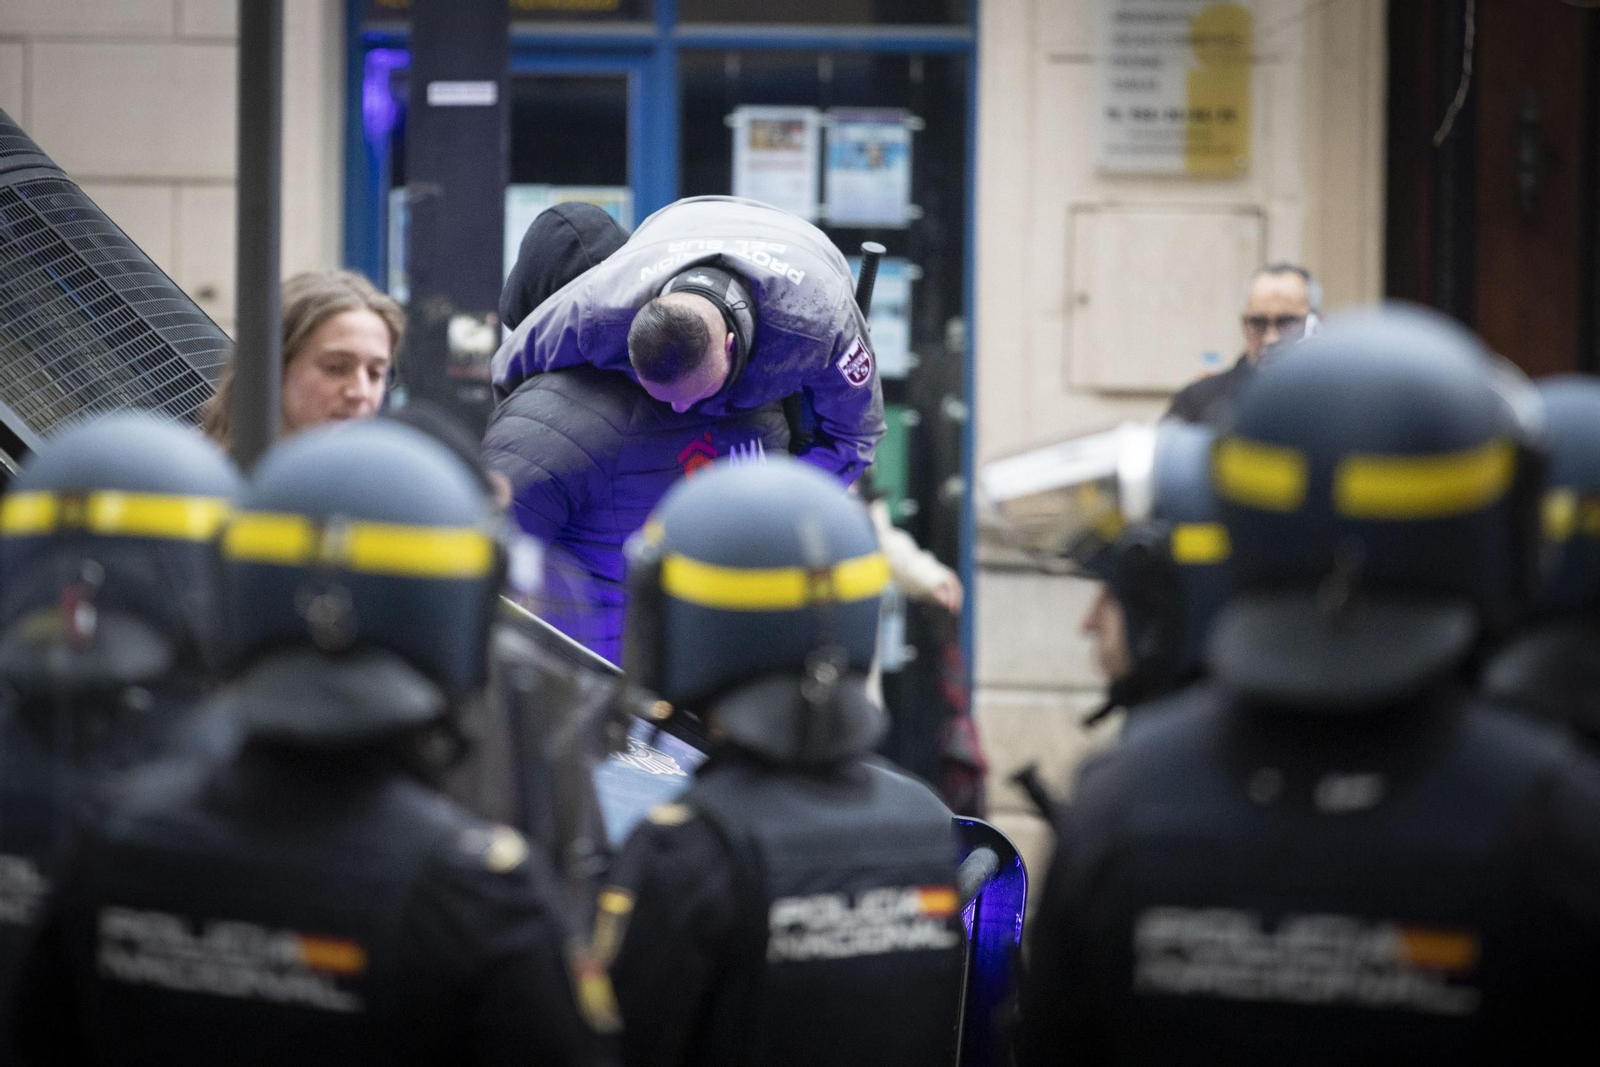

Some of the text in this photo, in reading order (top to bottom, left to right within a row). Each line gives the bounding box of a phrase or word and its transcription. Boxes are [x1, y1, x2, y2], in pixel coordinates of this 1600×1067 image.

[667, 239, 788, 255] DEL SUR
[640, 248, 806, 286] PROTION
